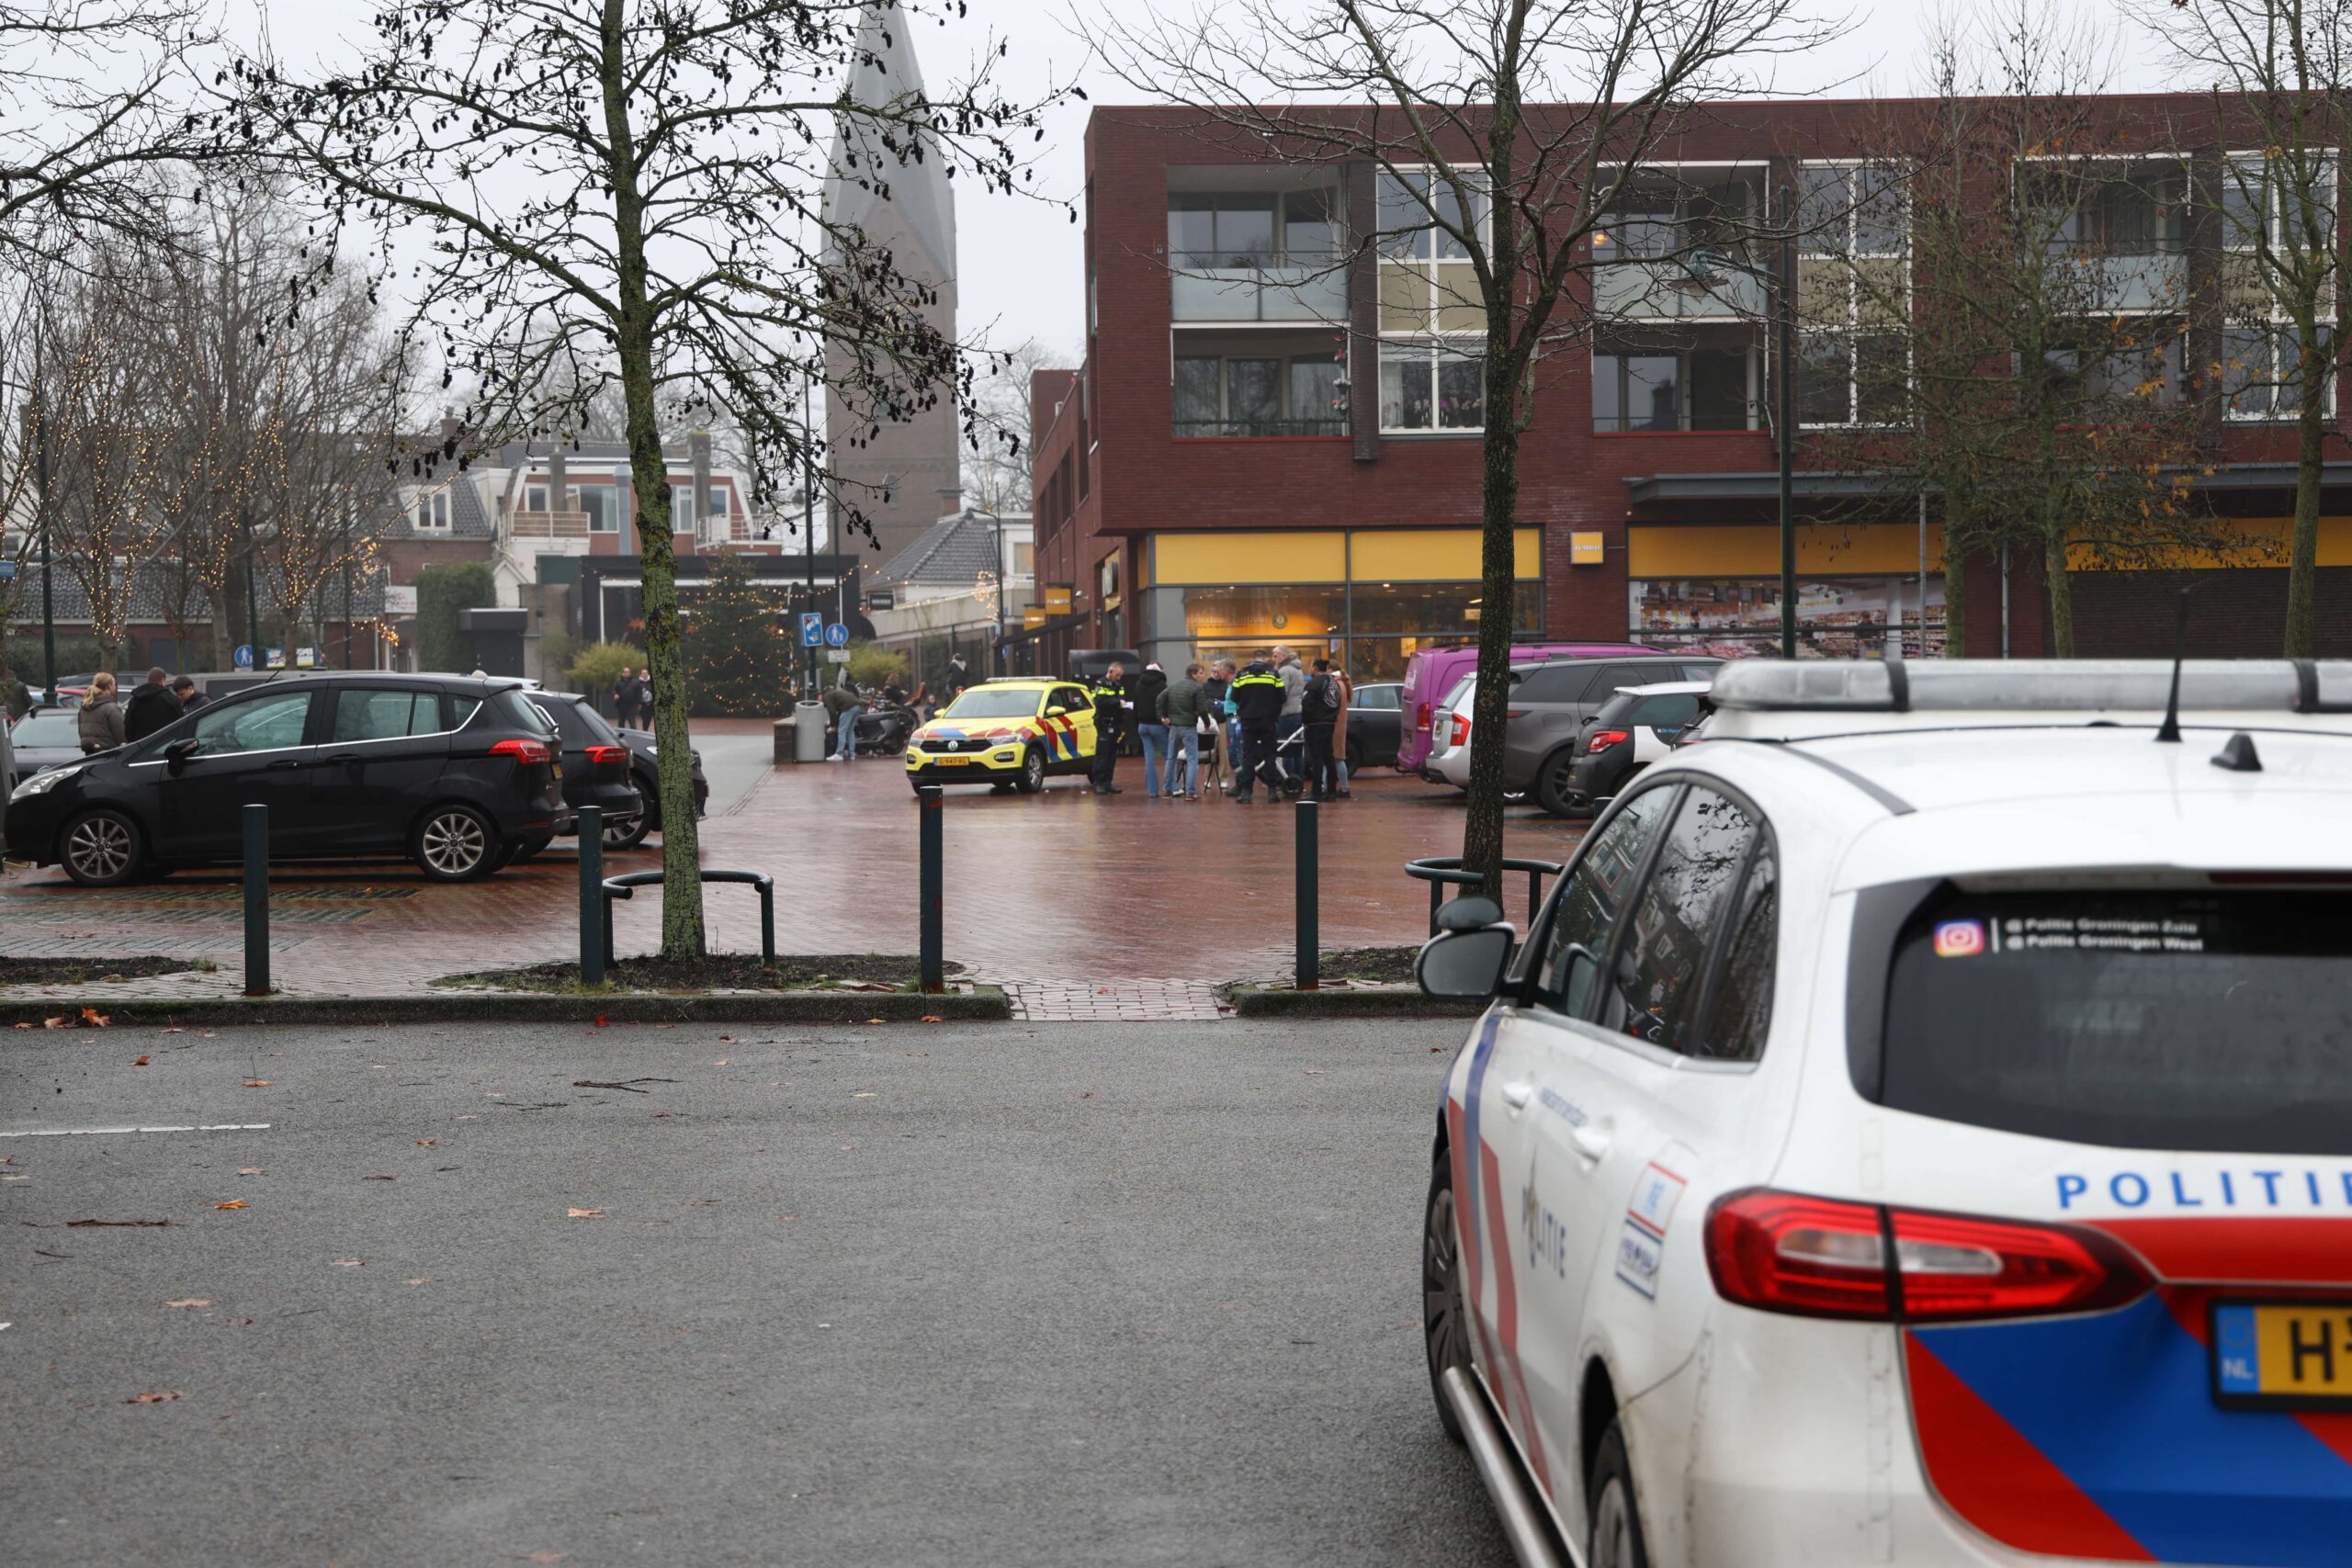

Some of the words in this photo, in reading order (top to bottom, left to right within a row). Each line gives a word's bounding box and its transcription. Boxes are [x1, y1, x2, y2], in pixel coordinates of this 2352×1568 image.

[2025, 918, 2074, 931] Politie
[2076, 918, 2159, 933] Groningen
[2027, 934, 2075, 947] Politie
[2078, 935, 2160, 950] Groningen
[2163, 938, 2203, 951] West
[2222, 1359, 2254, 1379] NL
